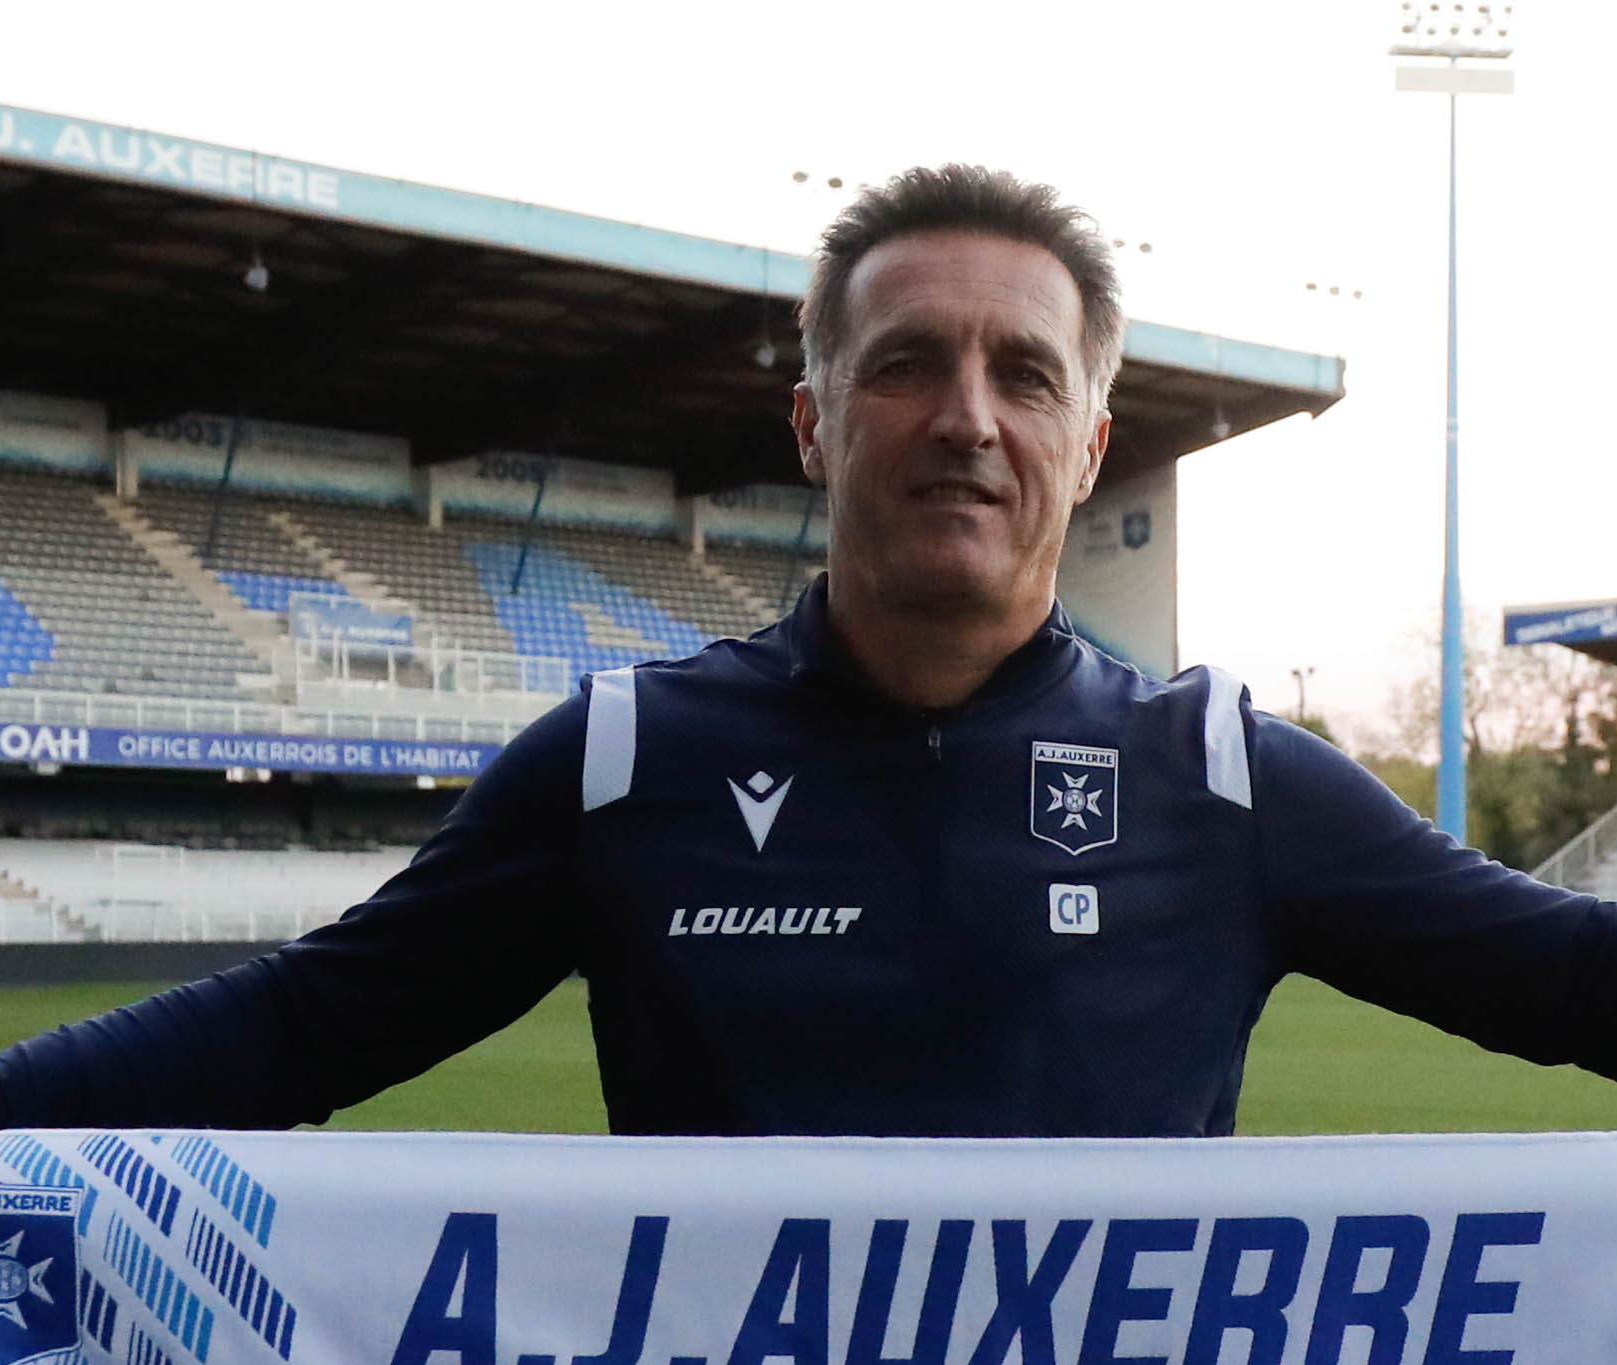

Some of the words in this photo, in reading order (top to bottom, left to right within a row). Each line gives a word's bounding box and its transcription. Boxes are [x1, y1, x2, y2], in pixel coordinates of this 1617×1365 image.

[52, 123, 340, 208] AUXERRE
[0, 724, 90, 760] OAH
[118, 735, 199, 760] OFFICE
[208, 740, 338, 765] AUXERROIS
[344, 745, 372, 765] DE
[381, 747, 480, 769] L'HABITAT
[1038, 750, 1113, 765] A.J.AUXERRE
[668, 907, 862, 936] LOUAULT
[1058, 893, 1090, 924] CP
